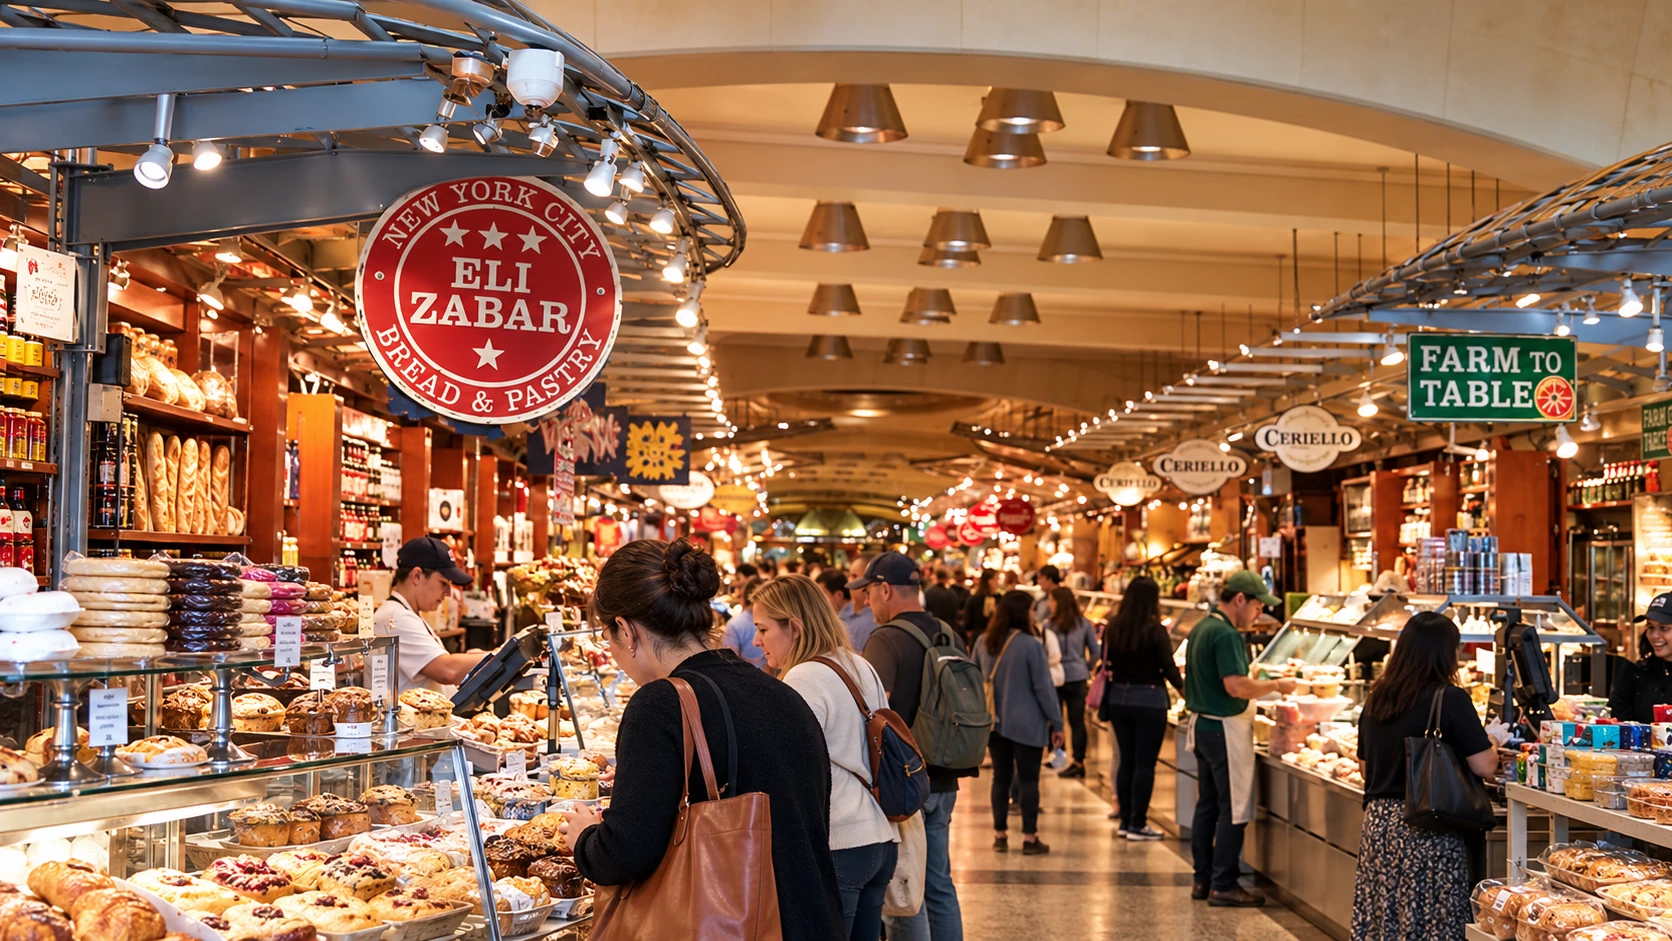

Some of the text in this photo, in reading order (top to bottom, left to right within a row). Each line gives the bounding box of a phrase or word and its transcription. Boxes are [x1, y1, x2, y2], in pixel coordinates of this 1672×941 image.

[382, 180, 601, 260] NEW YORK CITY
[451, 257, 532, 294] ELI
[410, 291, 571, 335] ZABAR
[376, 324, 602, 413] BREAD & PASTRY
[1420, 345, 1562, 373] FARM TO
[1419, 380, 1533, 408] TABLE
[1264, 429, 1353, 447] CERIELLO
[1160, 457, 1239, 473] CERIELLO
